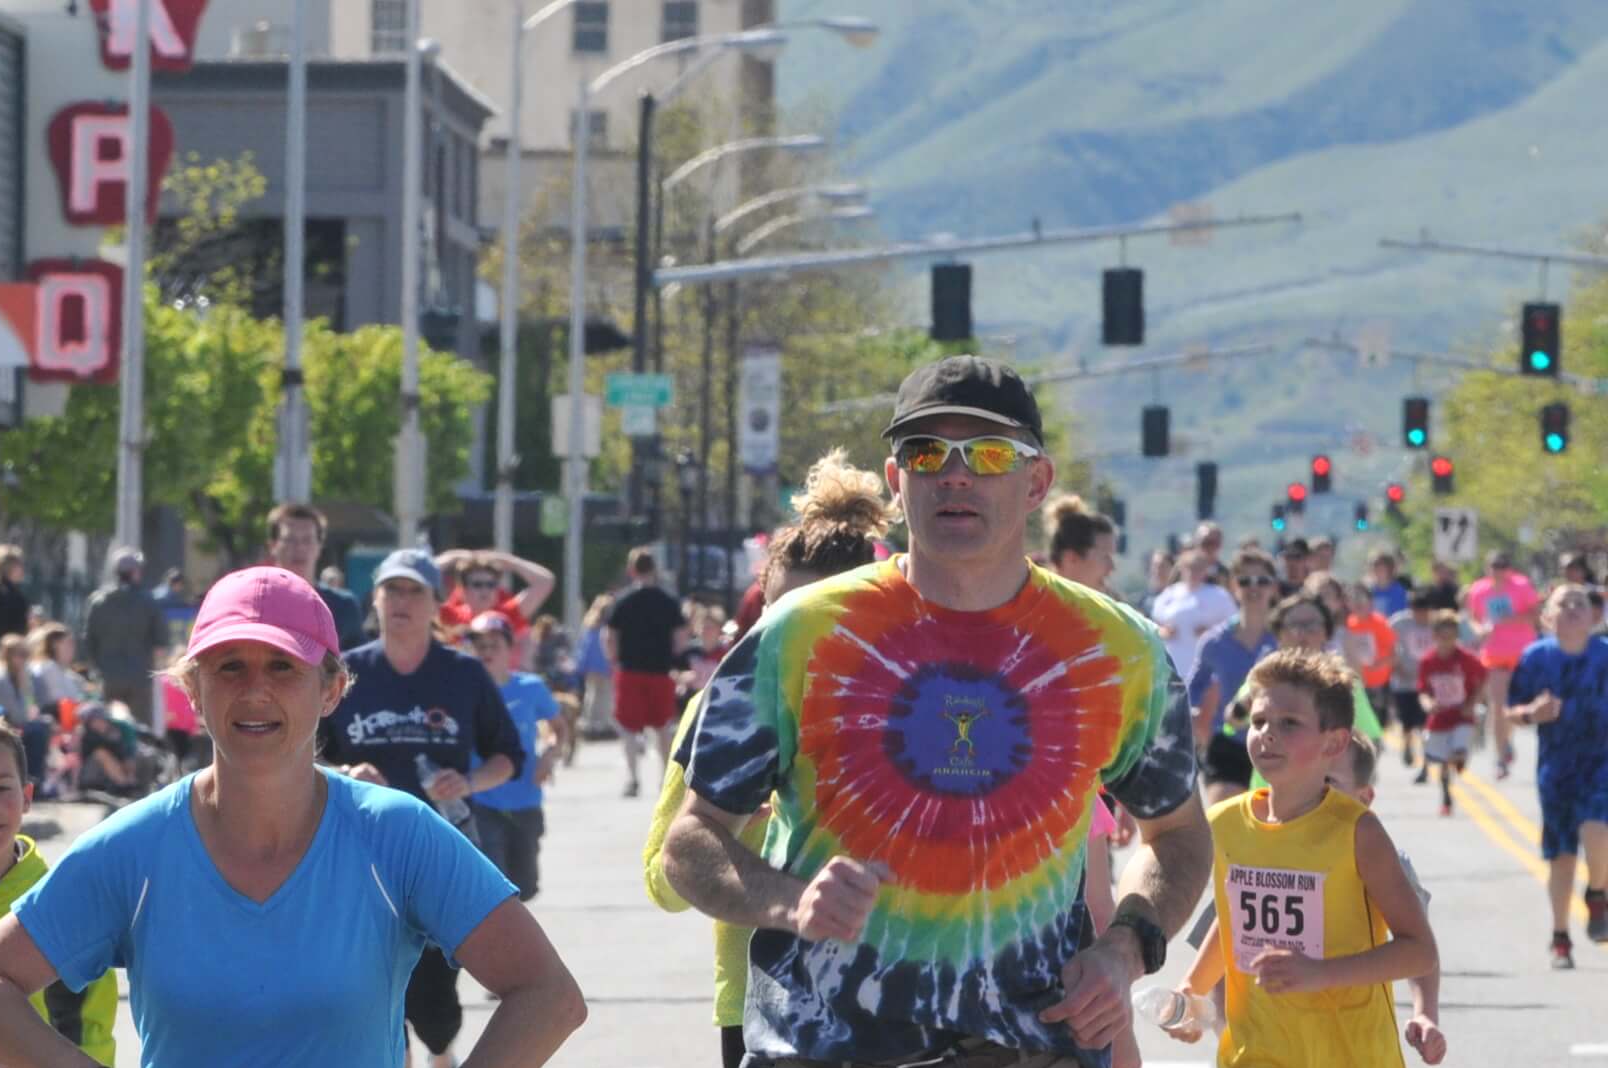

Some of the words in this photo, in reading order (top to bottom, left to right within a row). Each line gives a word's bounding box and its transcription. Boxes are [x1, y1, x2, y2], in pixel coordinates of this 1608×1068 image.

[1230, 869, 1253, 886] APPLE
[1255, 872, 1296, 890] BLOSSOM
[1297, 874, 1316, 891] RUN
[1240, 890, 1304, 936] 565
